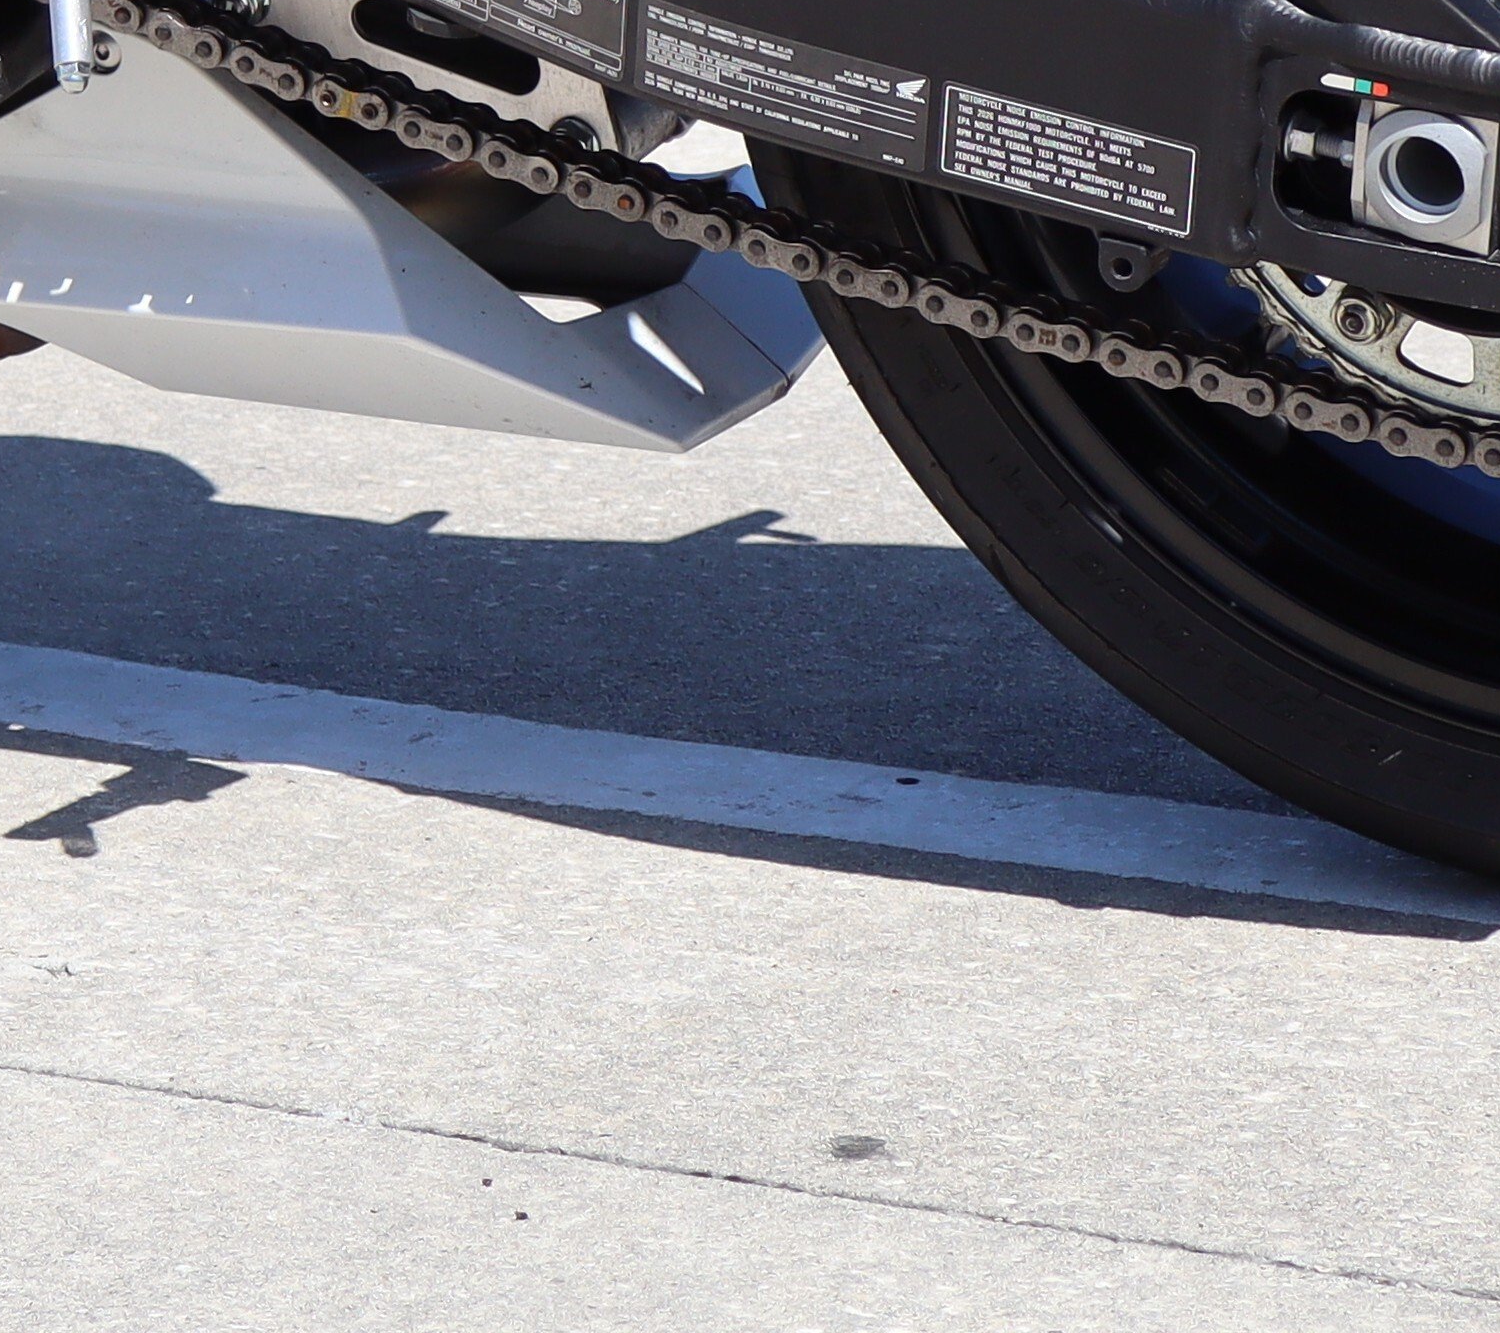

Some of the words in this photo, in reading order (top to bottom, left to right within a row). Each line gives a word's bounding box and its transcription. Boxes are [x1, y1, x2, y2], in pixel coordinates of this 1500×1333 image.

[896, 91, 925, 104] HONDA
[958, 92, 1001, 110] MOTORCYCLE
[1006, 104, 1025, 117] NOISE
[1030, 111, 1061, 126] EMISSION
[1065, 120, 1095, 135] CONTROL
[956, 126, 971, 138] RPM
[975, 131, 985, 141] BY
[989, 135, 1001, 146] THE
[1005, 139, 1033, 154] FEDERAL
[1037, 148, 1053, 160] TEST
[957, 103, 973, 115] THIS
[977, 108, 994, 120] 2026
[1109, 143, 1132, 157] MEETS
[957, 115, 970, 126] EPA
[974, 119, 993, 132] NOISE
[997, 125, 1029, 141] EMISSION
[1032, 135, 1082, 156] REQUIREMENTS
[1086, 149, 1094, 159] OF
[1124, 159, 1133, 169] AT
[1137, 162, 1154, 175] 5700
[954, 162, 965, 172] SEE
[970, 166, 999, 181] OWNER'S
[954, 149, 983, 165] FEDERAL
[987, 158, 1006, 171] NOISE
[1010, 164, 1049, 182] STANDARDS
[1053, 176, 1066, 187] ARE
[1070, 180, 1109, 198] PROHIBITED
[1112, 192, 1122, 202] BY
[1126, 195, 1155, 211] FEDERAL
[1159, 204, 1176, 216] LAW.
[955, 138, 1005, 158] MODIFICATIONS
[1009, 152, 1031, 165] WHICH
[1035, 159, 1057, 172] CAUSE
[1060, 166, 1076, 177] THIS
[1079, 171, 1124, 190] MOTORCYCLE
[1128, 184, 1137, 194] TO
[1141, 187, 1166, 202] EXCEED
